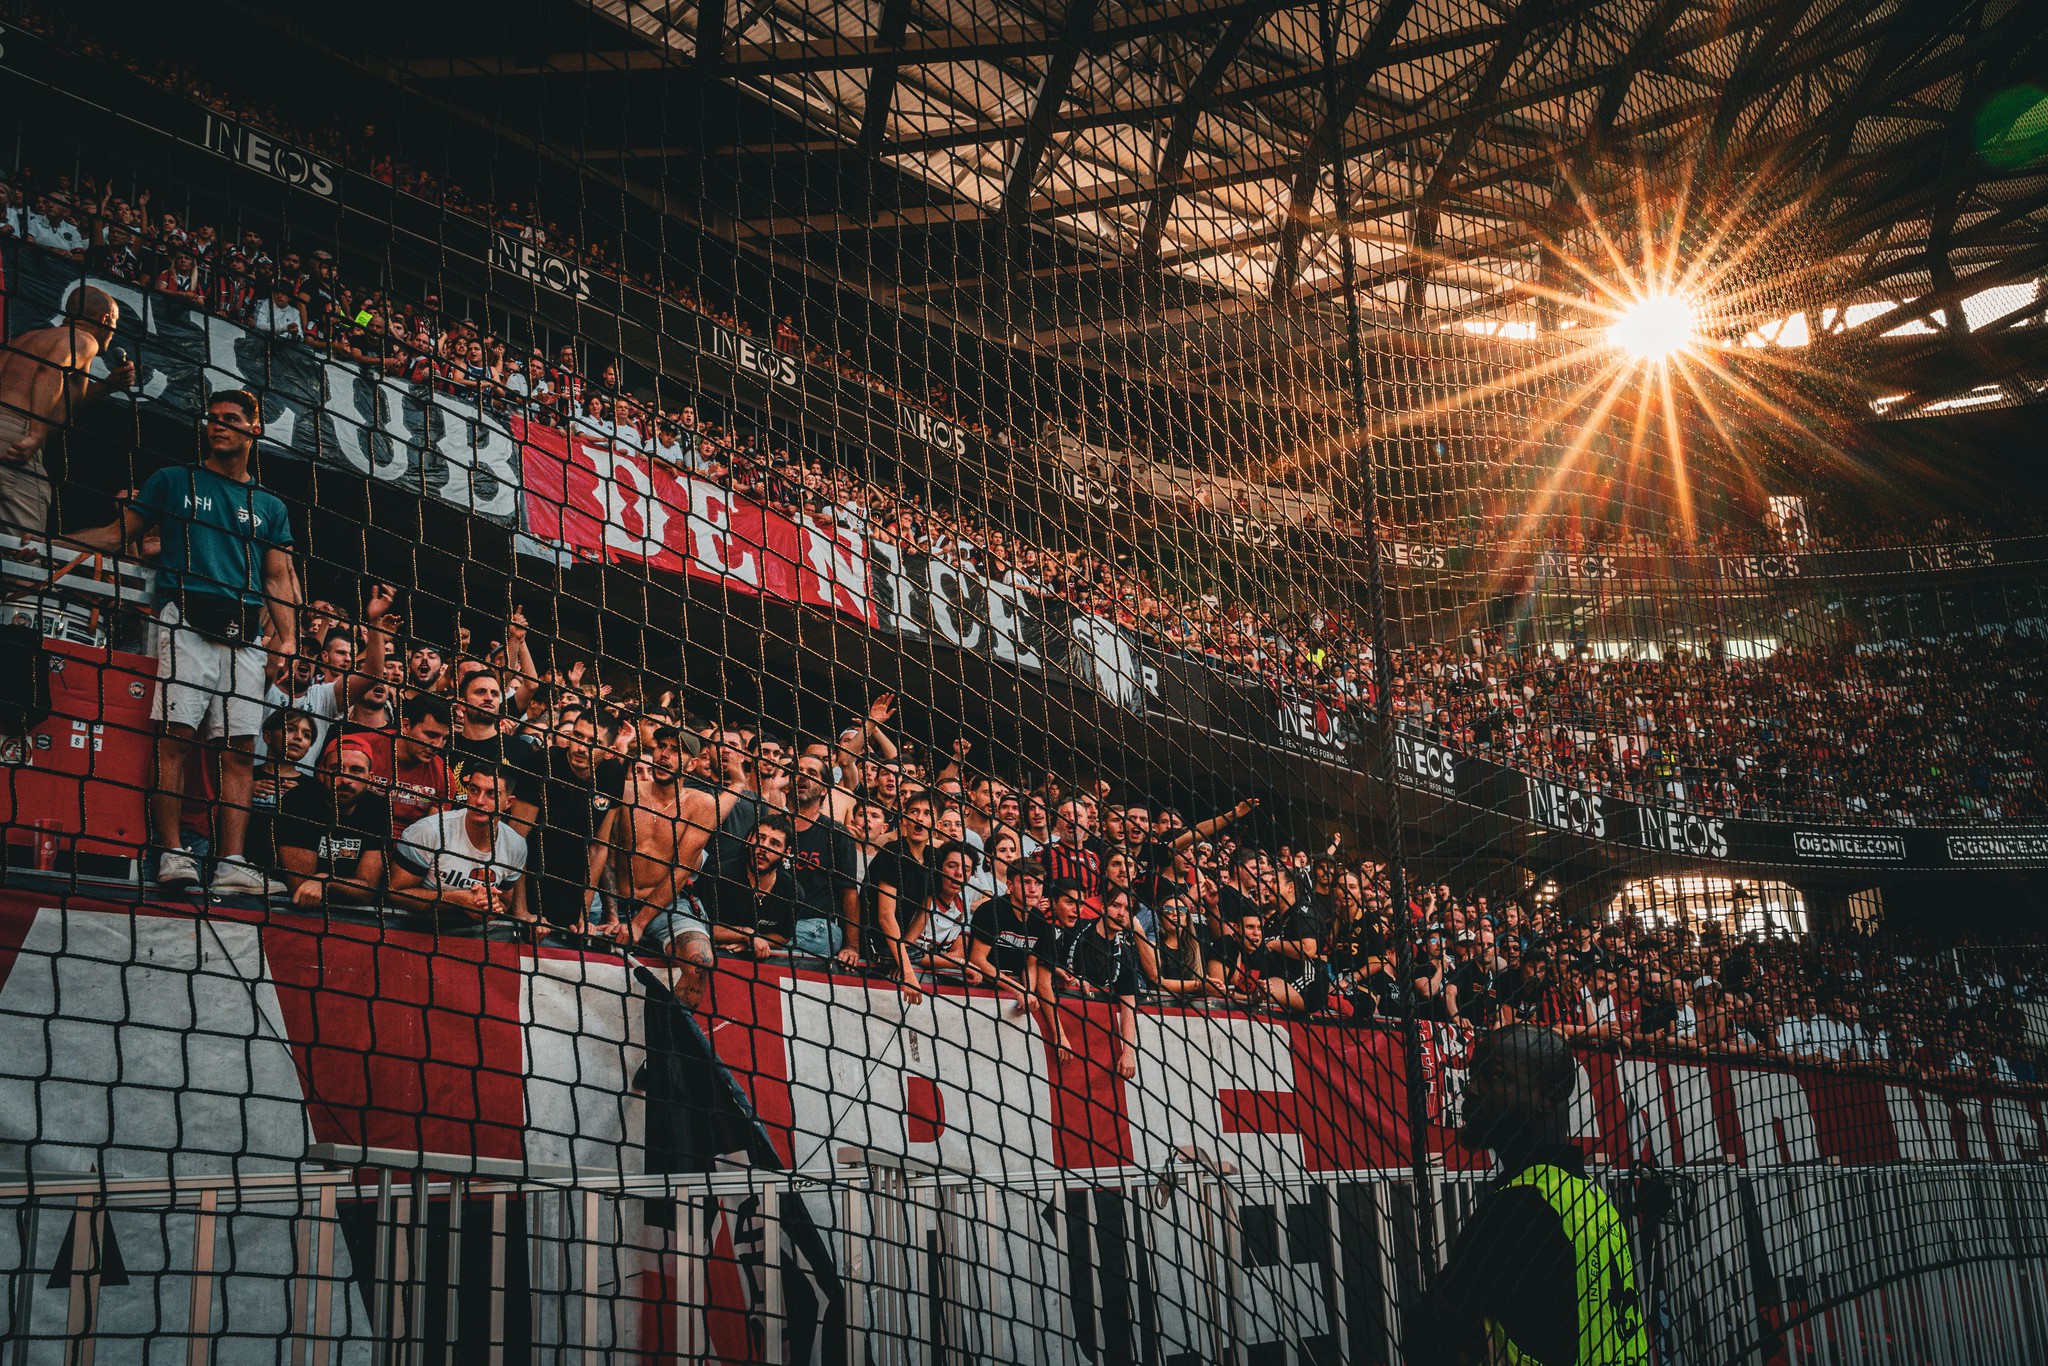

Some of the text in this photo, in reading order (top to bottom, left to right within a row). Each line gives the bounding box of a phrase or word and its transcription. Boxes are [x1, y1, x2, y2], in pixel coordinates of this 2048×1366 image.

[202, 114, 334, 196] INEOS
[488, 236, 591, 300] INEOS
[712, 326, 796, 385] INEOS
[898, 404, 966, 455] NEOS
[58, 278, 1041, 668] CLUB DE NICE
[1052, 467, 1119, 510] INEOS
[1378, 541, 1445, 569] NEOS
[1539, 555, 1617, 578] INEOS
[1717, 556, 1800, 578] INEOS
[1395, 735, 1455, 784] INEOS
[1399, 772, 1456, 796] SCIENE PRFORANC
[1525, 776, 1605, 838] INEOS
[1638, 806, 1728, 858] INEOS
[1799, 837, 1900, 854] OGCNICE.COM
[438, 869, 500, 890] elle
